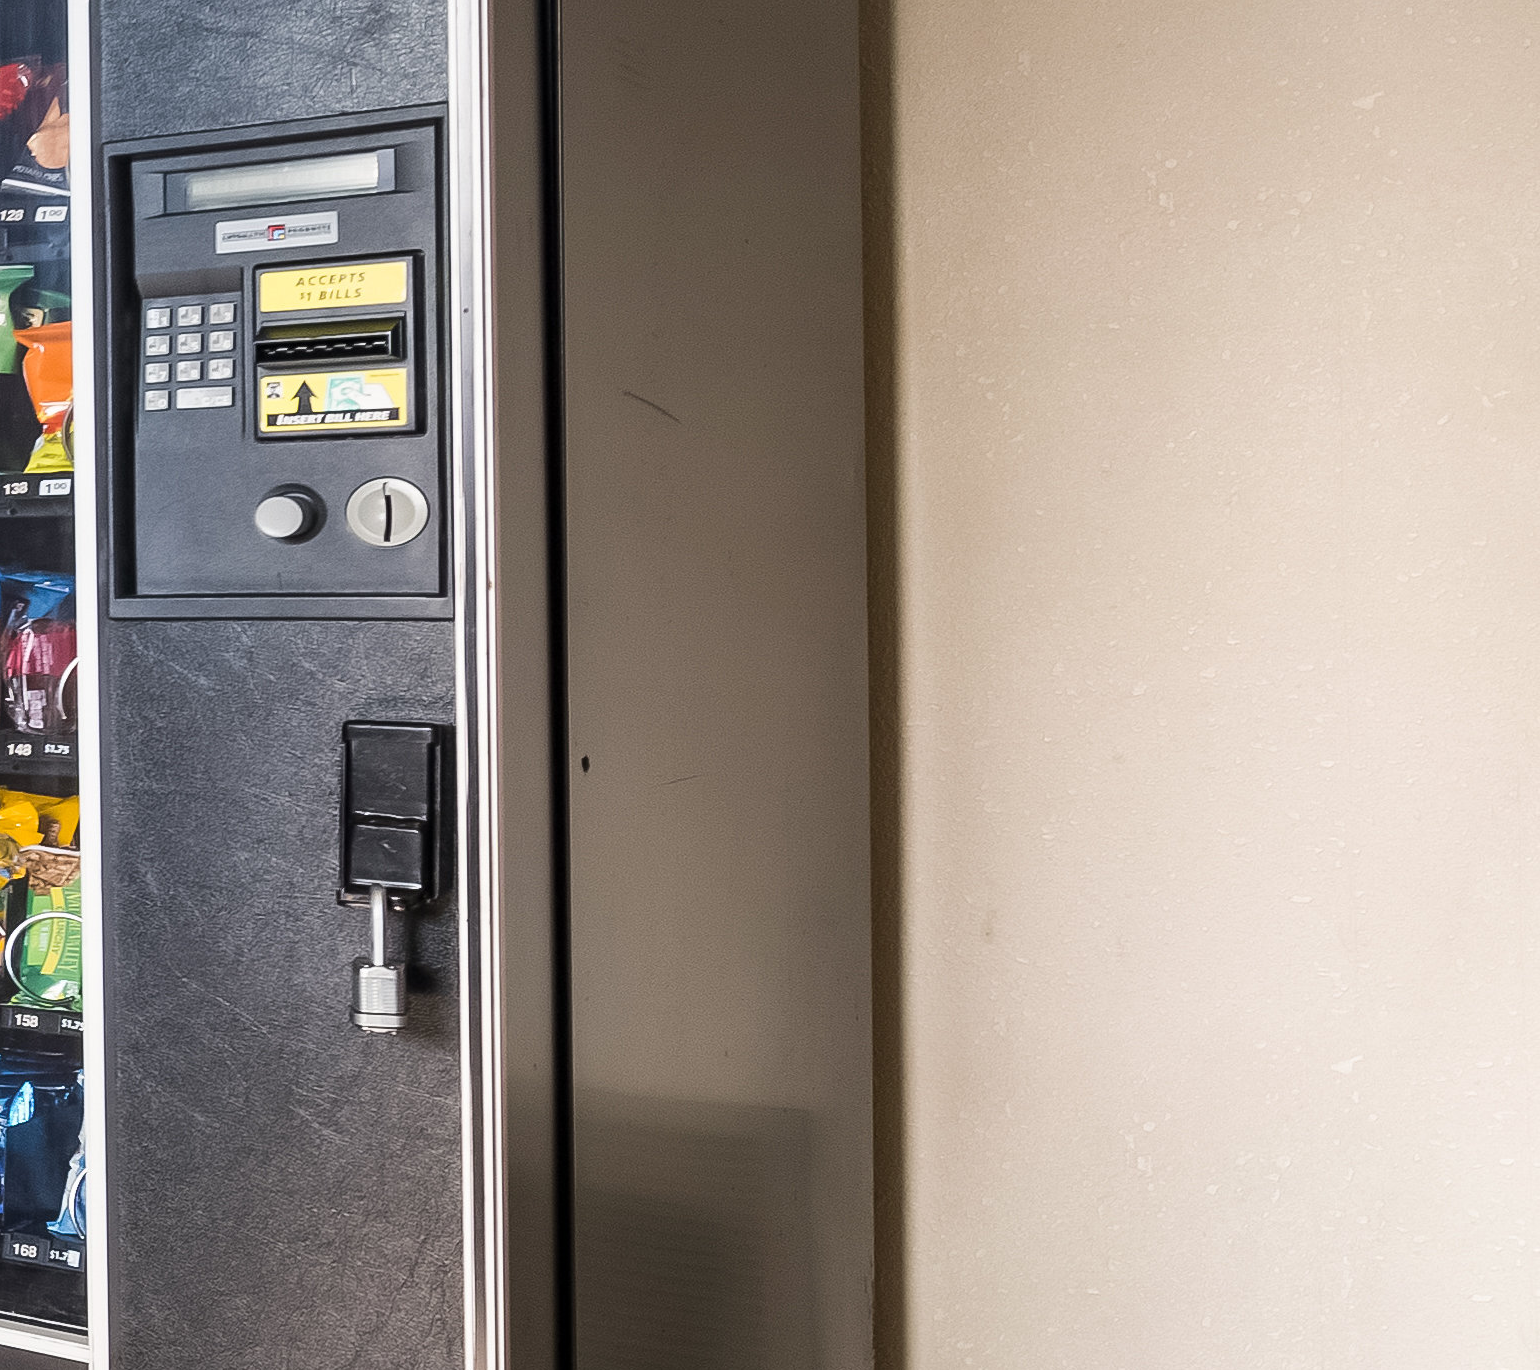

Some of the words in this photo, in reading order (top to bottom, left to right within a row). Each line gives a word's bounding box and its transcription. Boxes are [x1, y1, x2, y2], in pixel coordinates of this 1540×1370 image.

[296, 271, 365, 287] ACCEPTS
[319, 288, 362, 300] BILLS
[276, 413, 325, 425] INSERT
[324, 412, 353, 423] BILL
[354, 410, 390, 421] HERE
